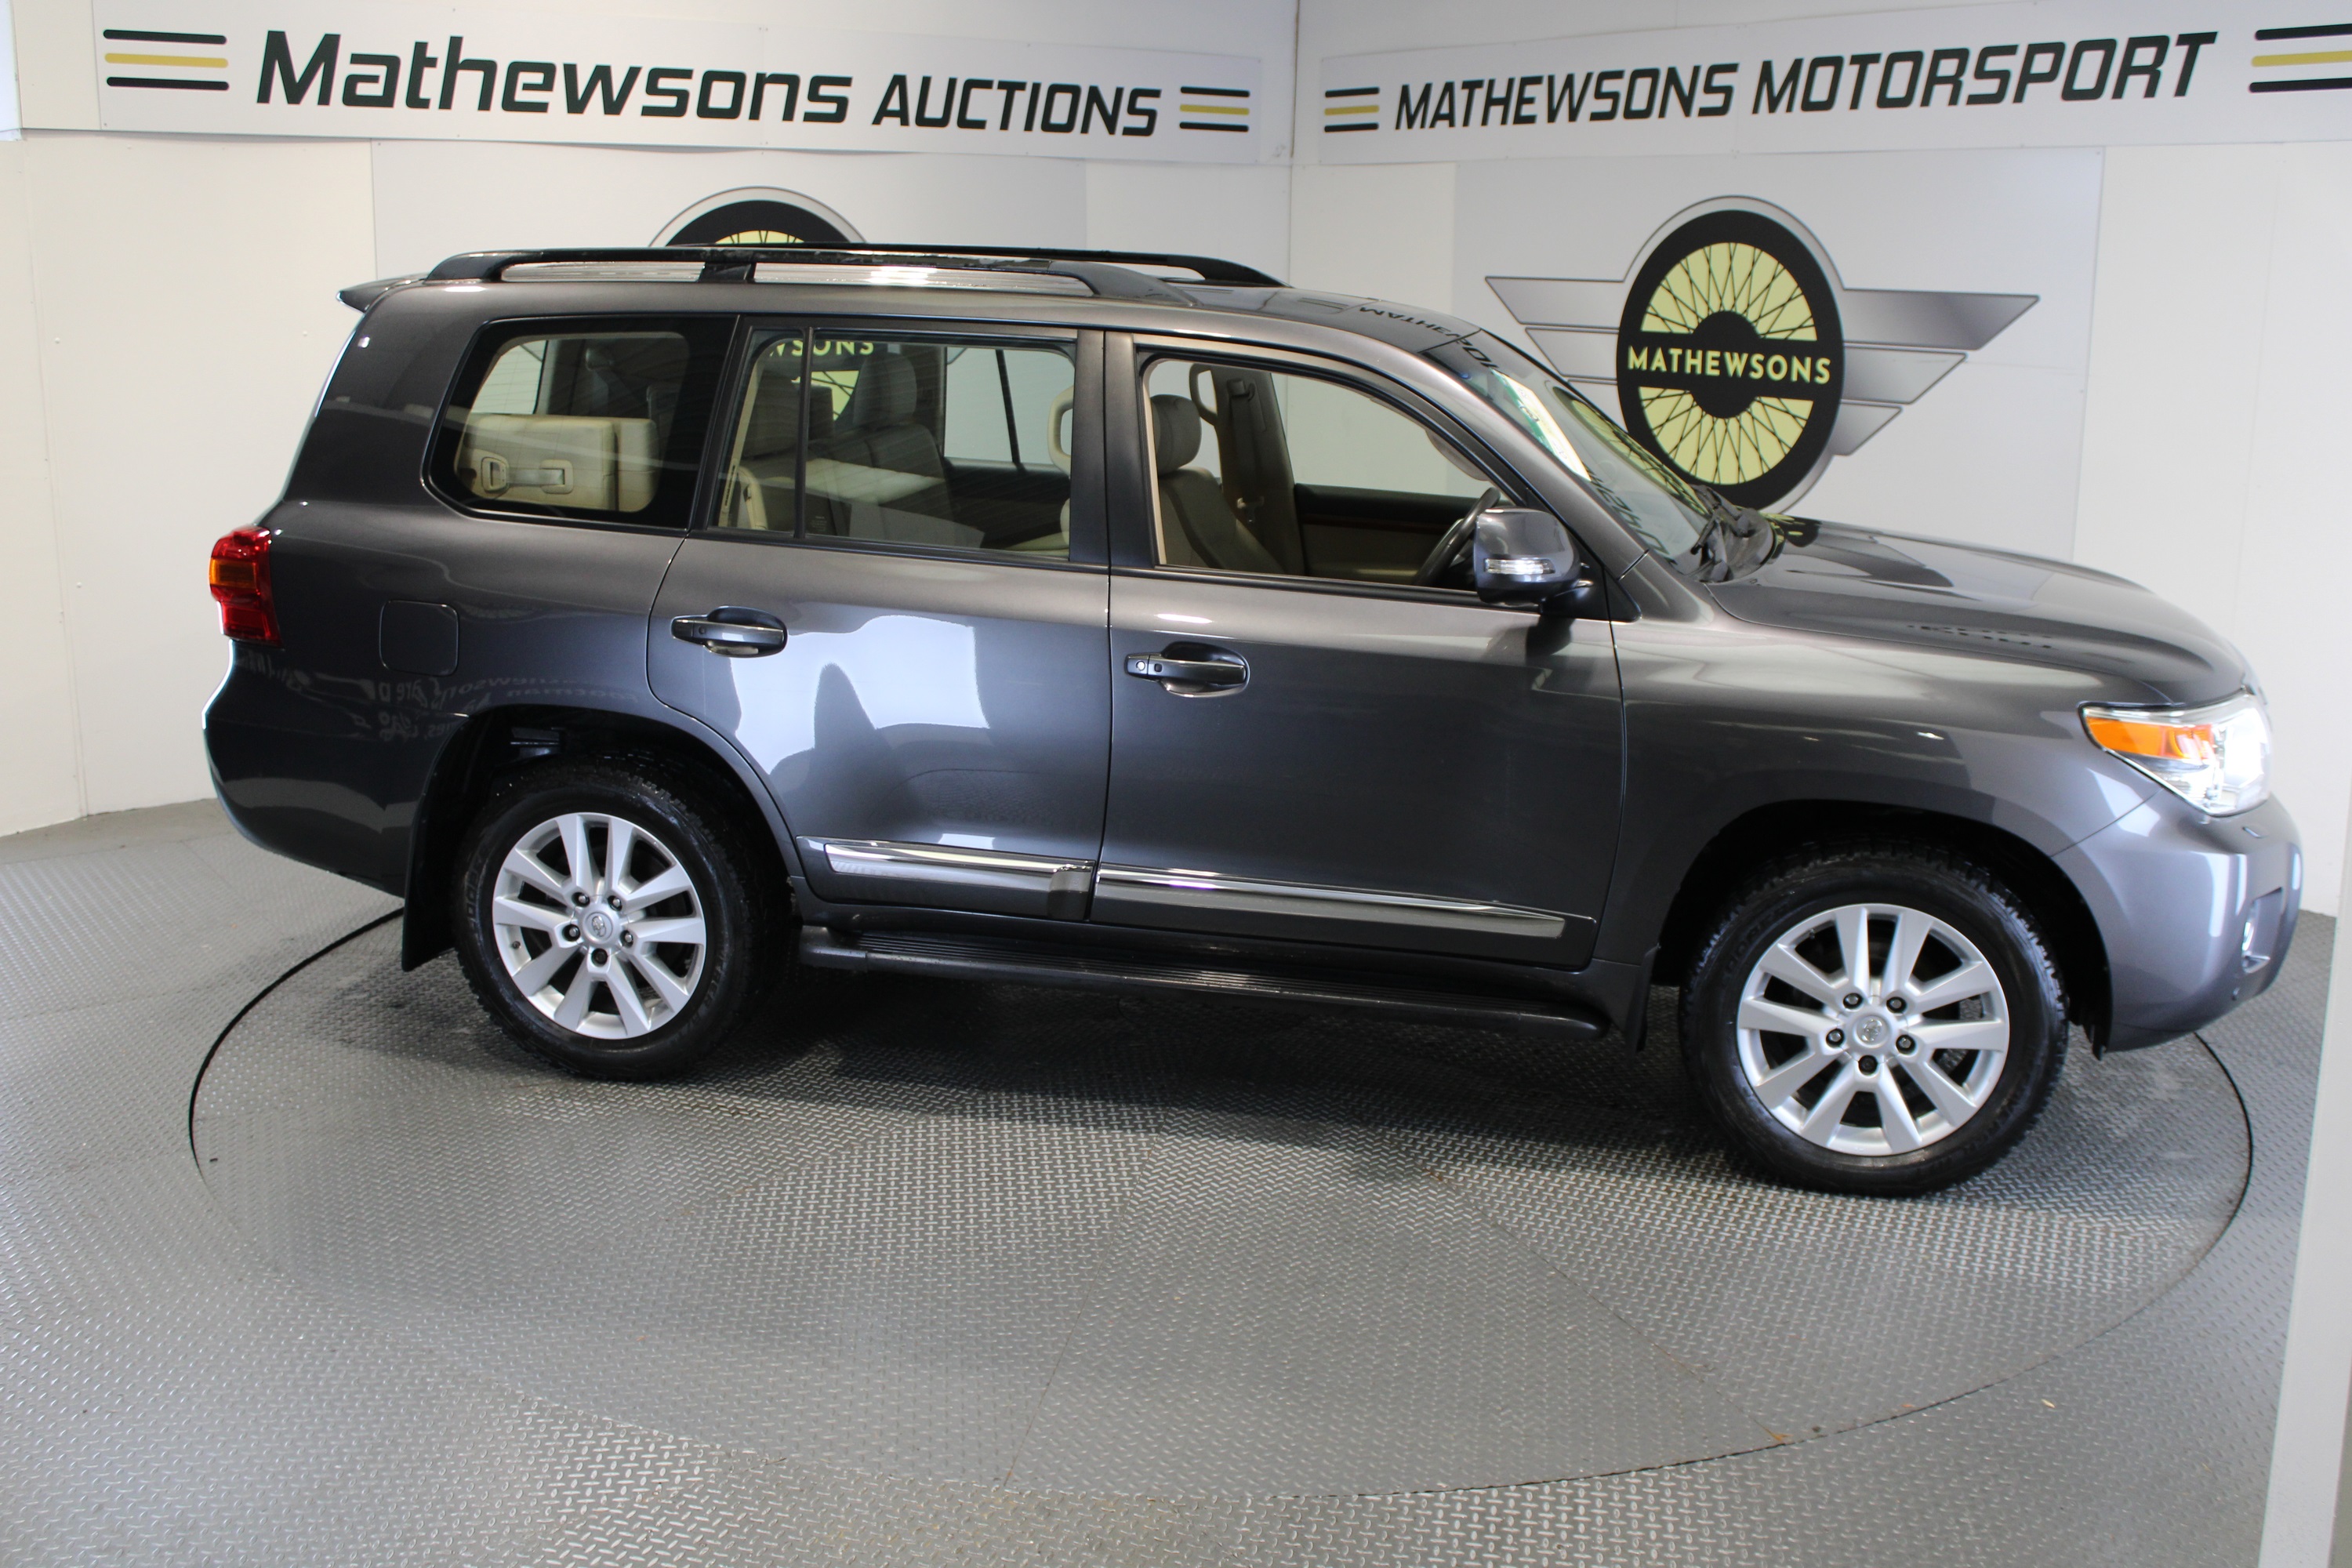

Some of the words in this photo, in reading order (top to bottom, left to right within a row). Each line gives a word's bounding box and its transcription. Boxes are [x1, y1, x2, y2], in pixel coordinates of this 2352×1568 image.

[256, 30, 853, 123] Mathewsons
[871, 74, 1162, 136] AUCTIONS
[1395, 63, 1739, 131] MATHEWSONS
[1751, 31, 2218, 114] MOTORSPORT
[1628, 346, 1831, 385] MATHEWSONS
